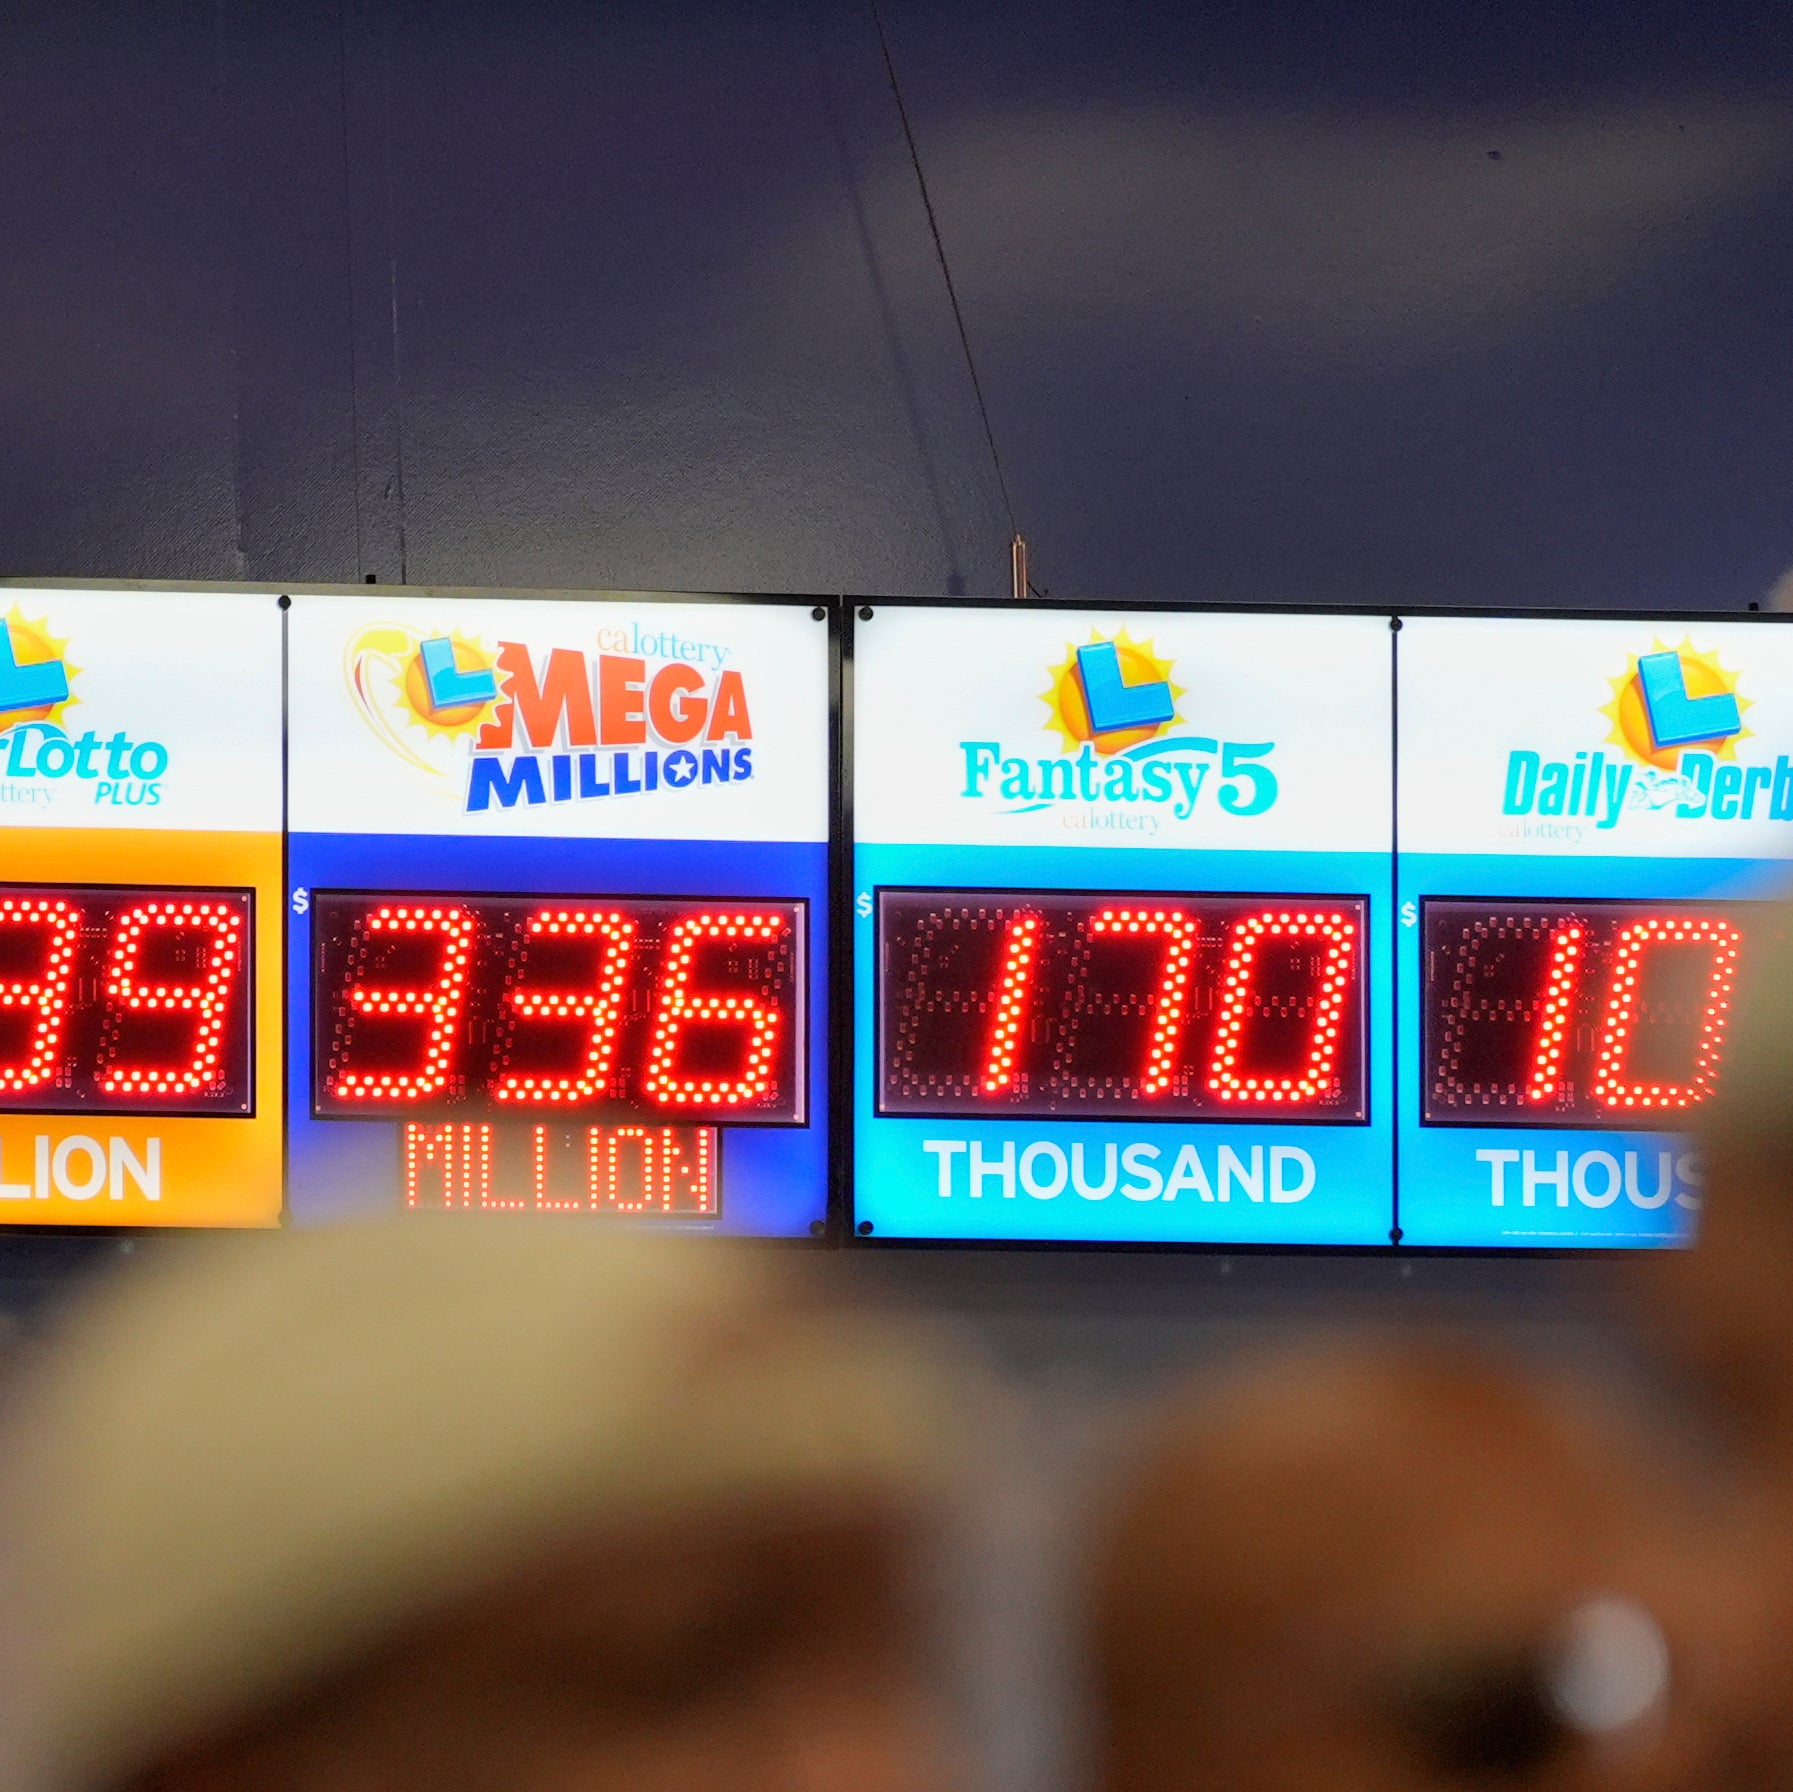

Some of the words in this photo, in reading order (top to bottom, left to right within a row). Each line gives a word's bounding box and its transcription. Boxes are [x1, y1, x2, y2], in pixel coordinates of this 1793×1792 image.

[596, 621, 732, 671] calottery
[474, 640, 753, 751] MEGA
[94, 781, 162, 806] PLUS
[464, 747, 753, 813] MILLIONS
[959, 739, 1210, 821] Fantasy
[1217, 741, 1278, 818] 5
[1502, 750, 1632, 829] Daily
[1062, 808, 1161, 836] calottery
[336, 906, 785, 1105] 336
[983, 909, 1356, 1103] 170
[406, 1122, 709, 1212] MILLION
[922, 1139, 1316, 1204] THOUSAND
